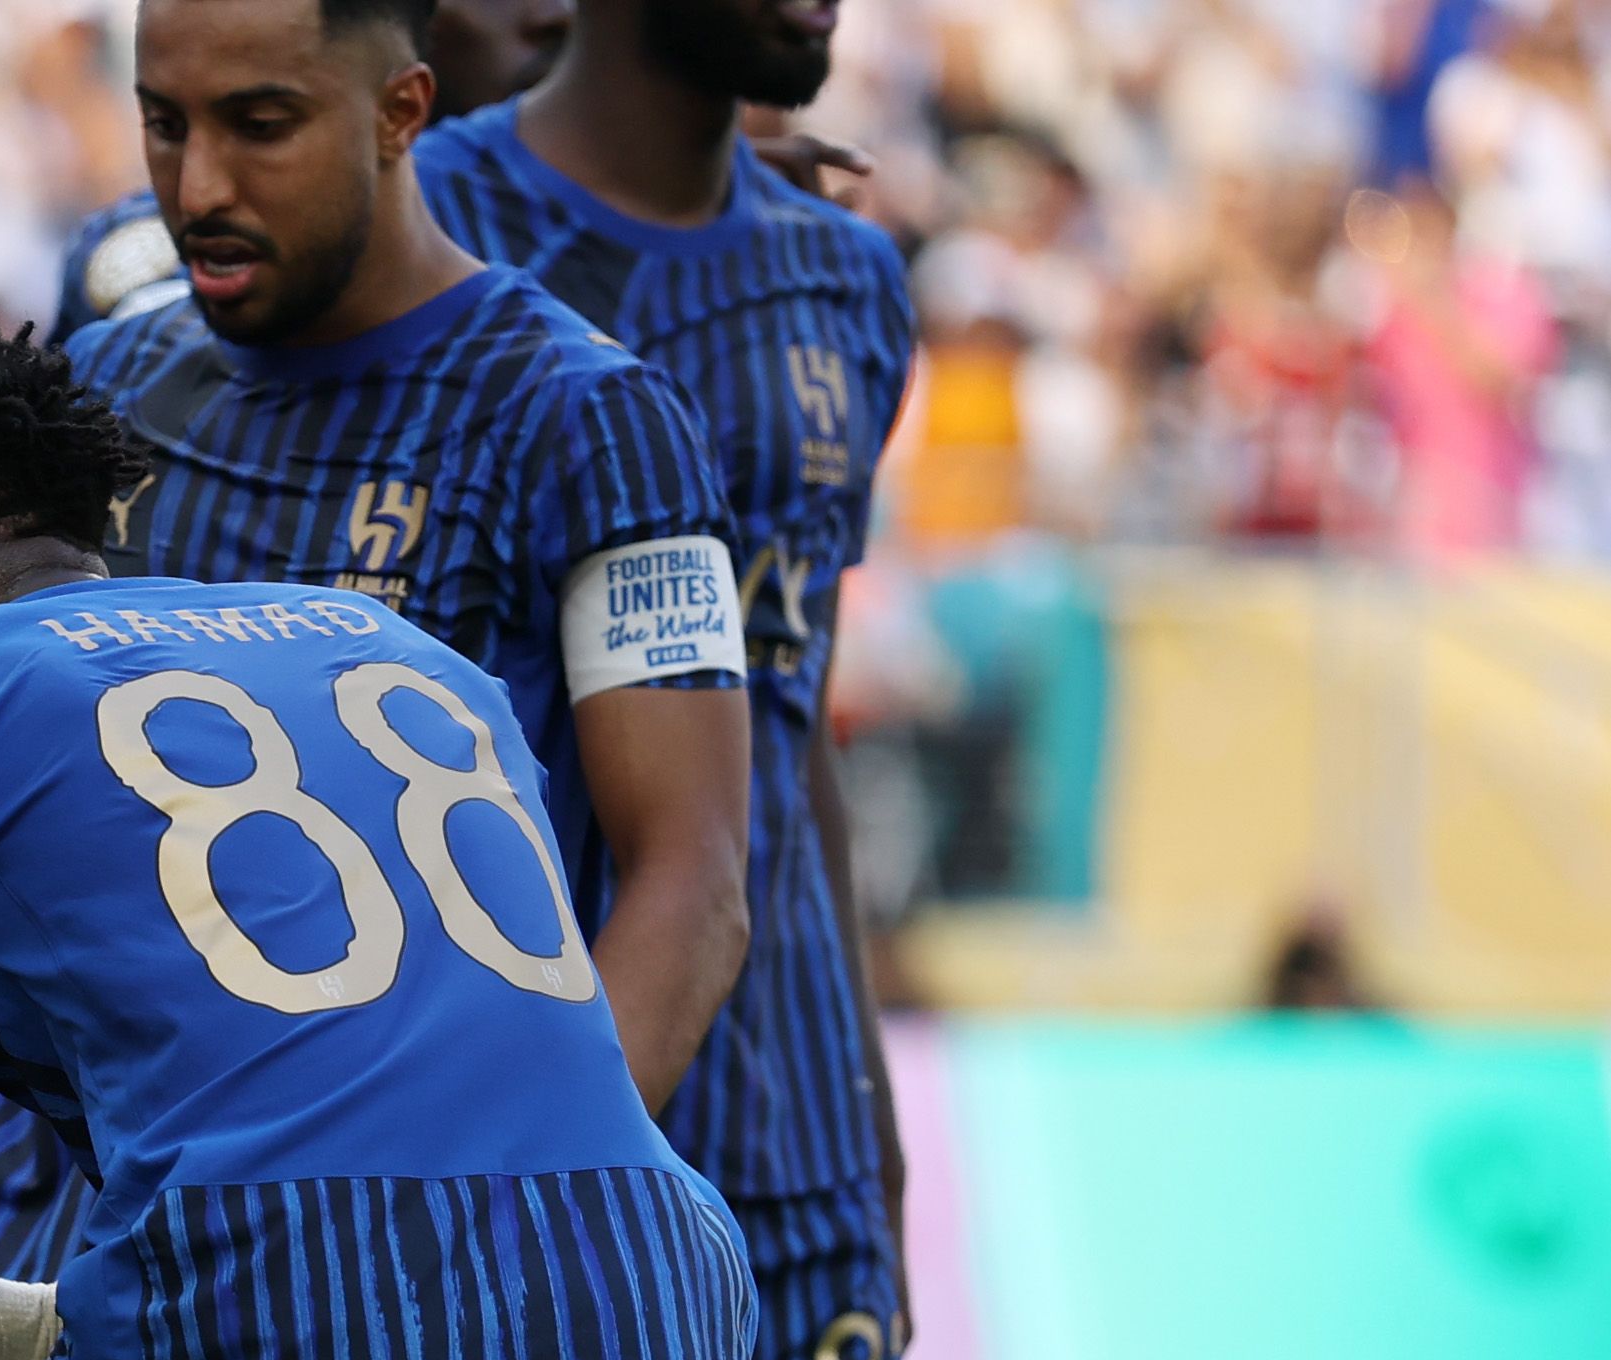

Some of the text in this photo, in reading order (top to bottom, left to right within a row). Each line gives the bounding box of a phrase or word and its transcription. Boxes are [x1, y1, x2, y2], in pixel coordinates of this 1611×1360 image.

[606, 548, 713, 584] FOOTBALL
[608, 575, 718, 618] UNITES
[39, 601, 380, 651] HAMAD
[602, 609, 726, 651] the World
[96, 661, 598, 1016] 88
